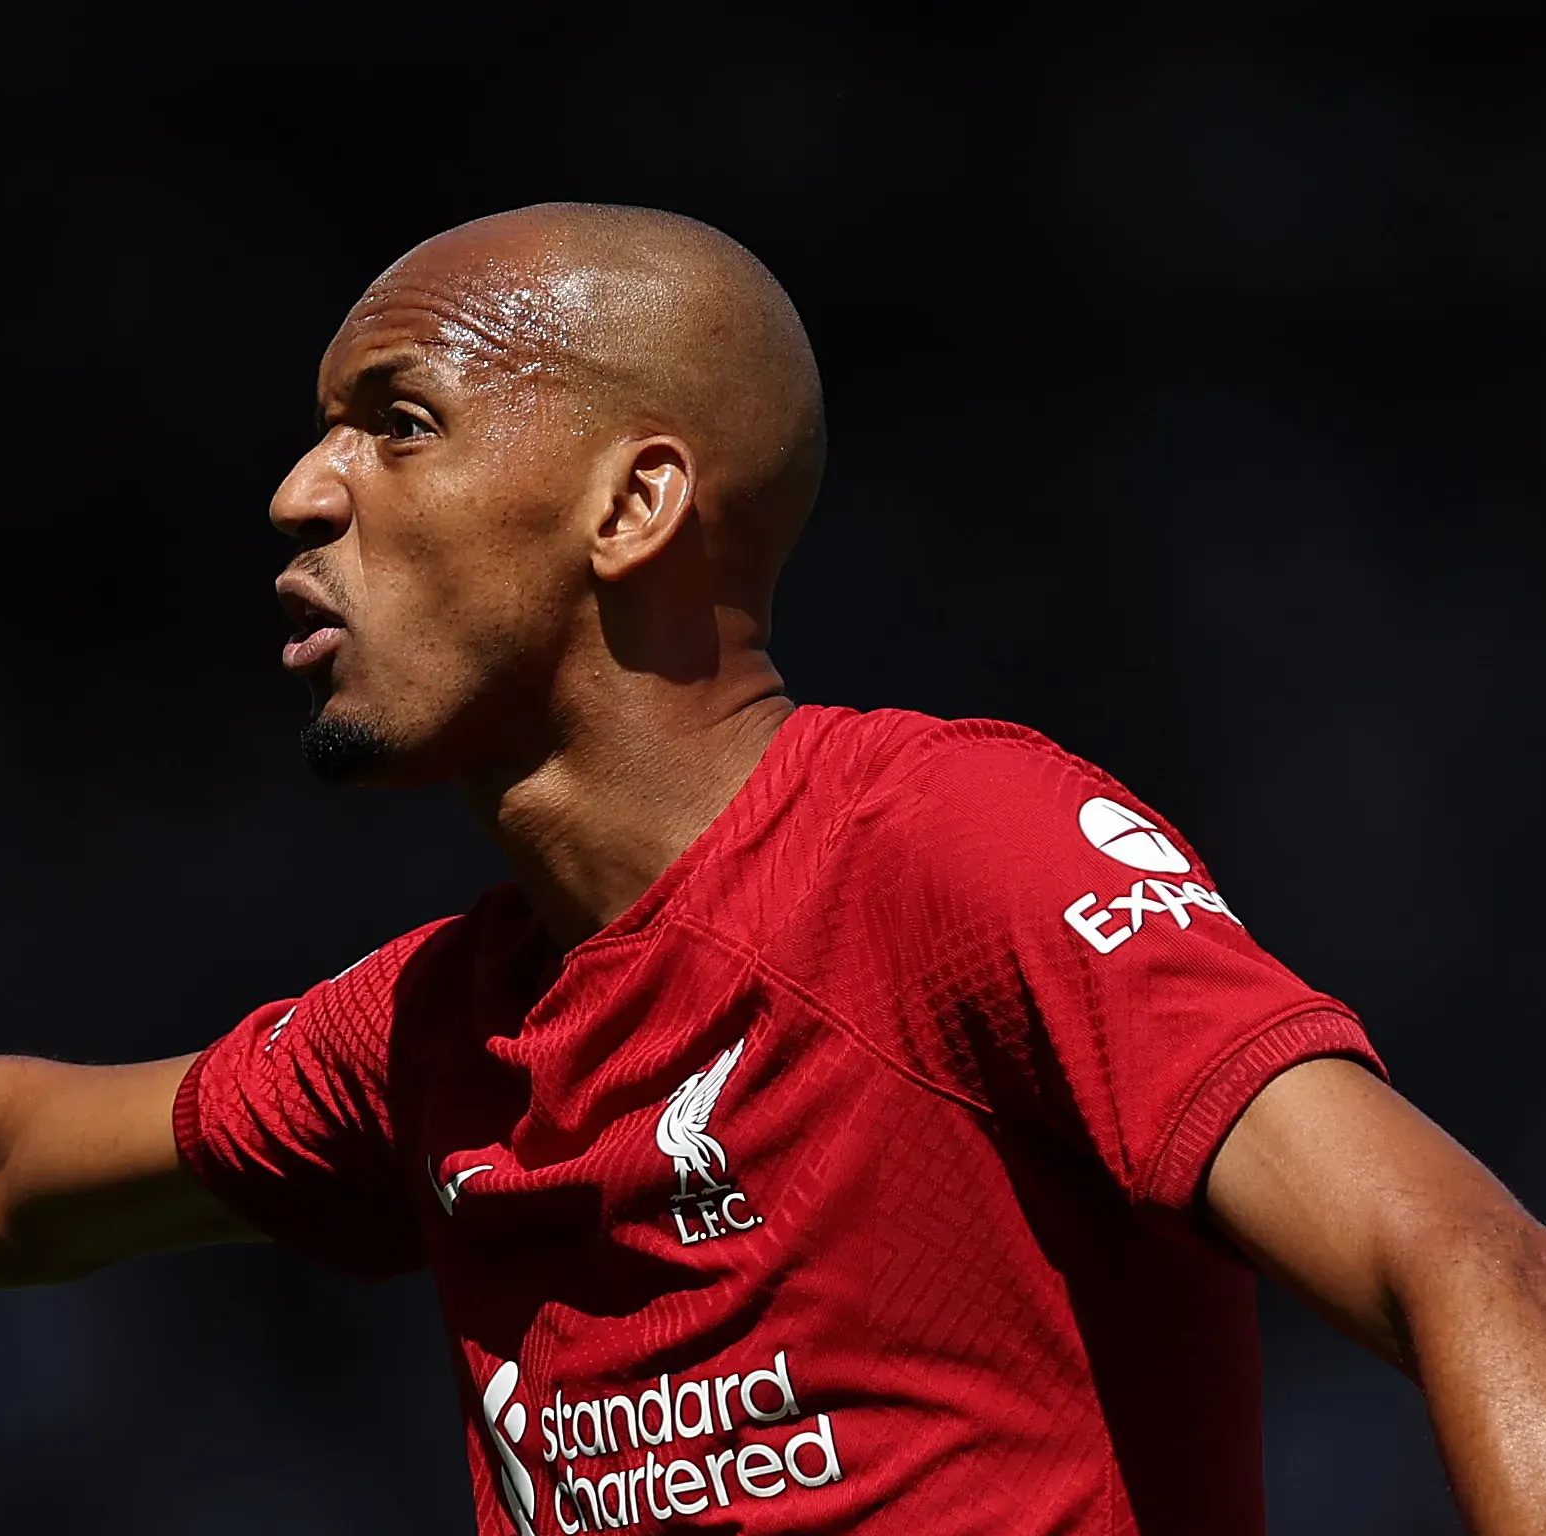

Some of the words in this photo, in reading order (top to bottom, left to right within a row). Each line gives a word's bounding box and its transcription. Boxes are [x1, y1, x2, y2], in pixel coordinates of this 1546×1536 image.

[671, 1192, 763, 1244] L.F.C.
[540, 1351, 799, 1462] standard
[554, 1414, 842, 1535] chartered
